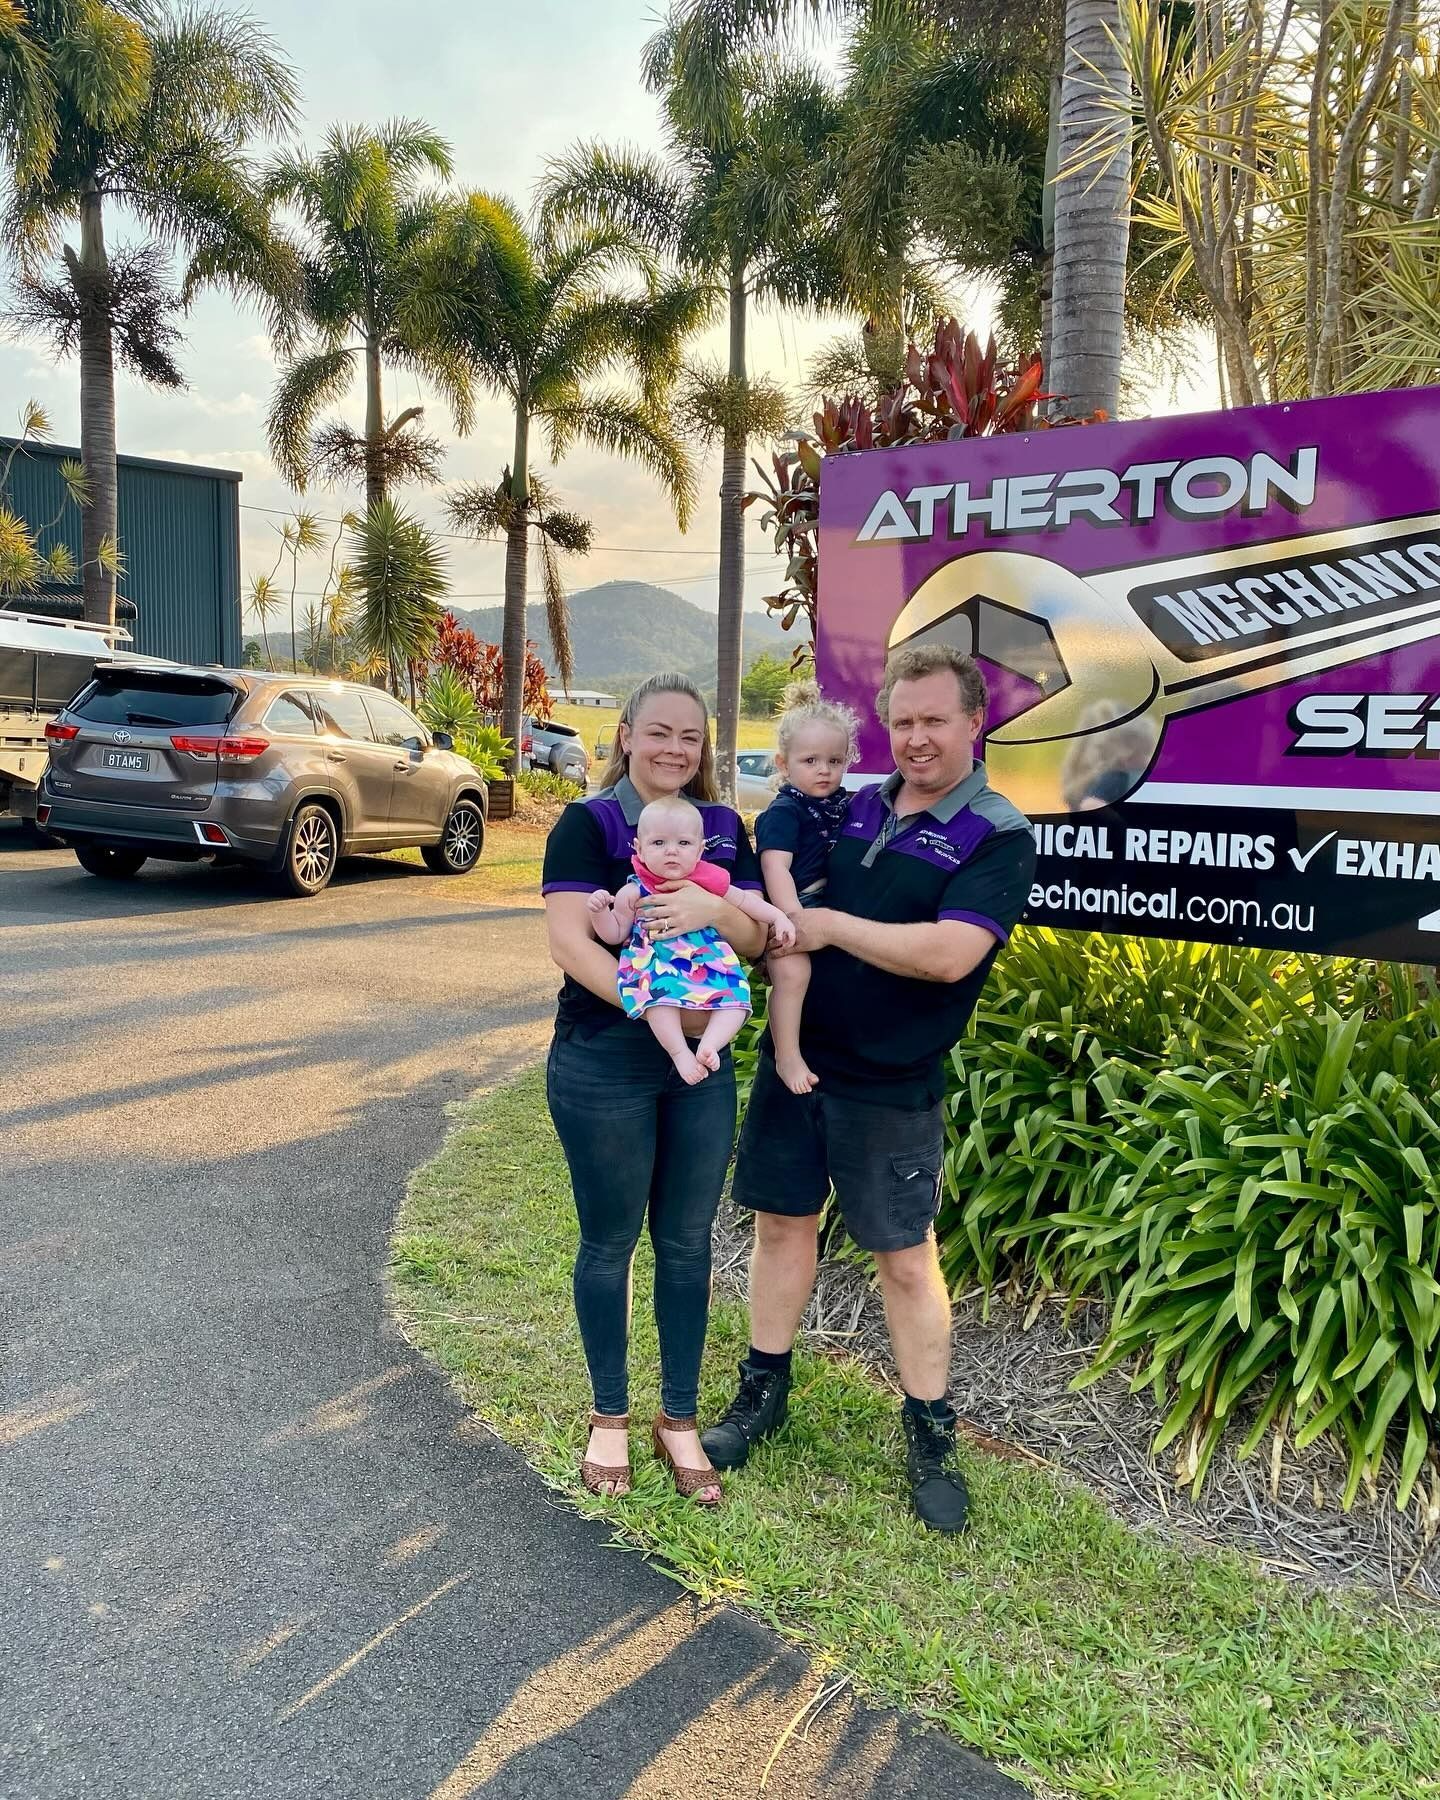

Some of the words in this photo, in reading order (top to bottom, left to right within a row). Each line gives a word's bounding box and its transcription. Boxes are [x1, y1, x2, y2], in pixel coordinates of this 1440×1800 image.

[856, 447, 1317, 542] ATHERTON
[1294, 694, 1440, 750] SE
[1125, 828, 1276, 871] REPAIRS
[1335, 839, 1440, 881] EXHA
